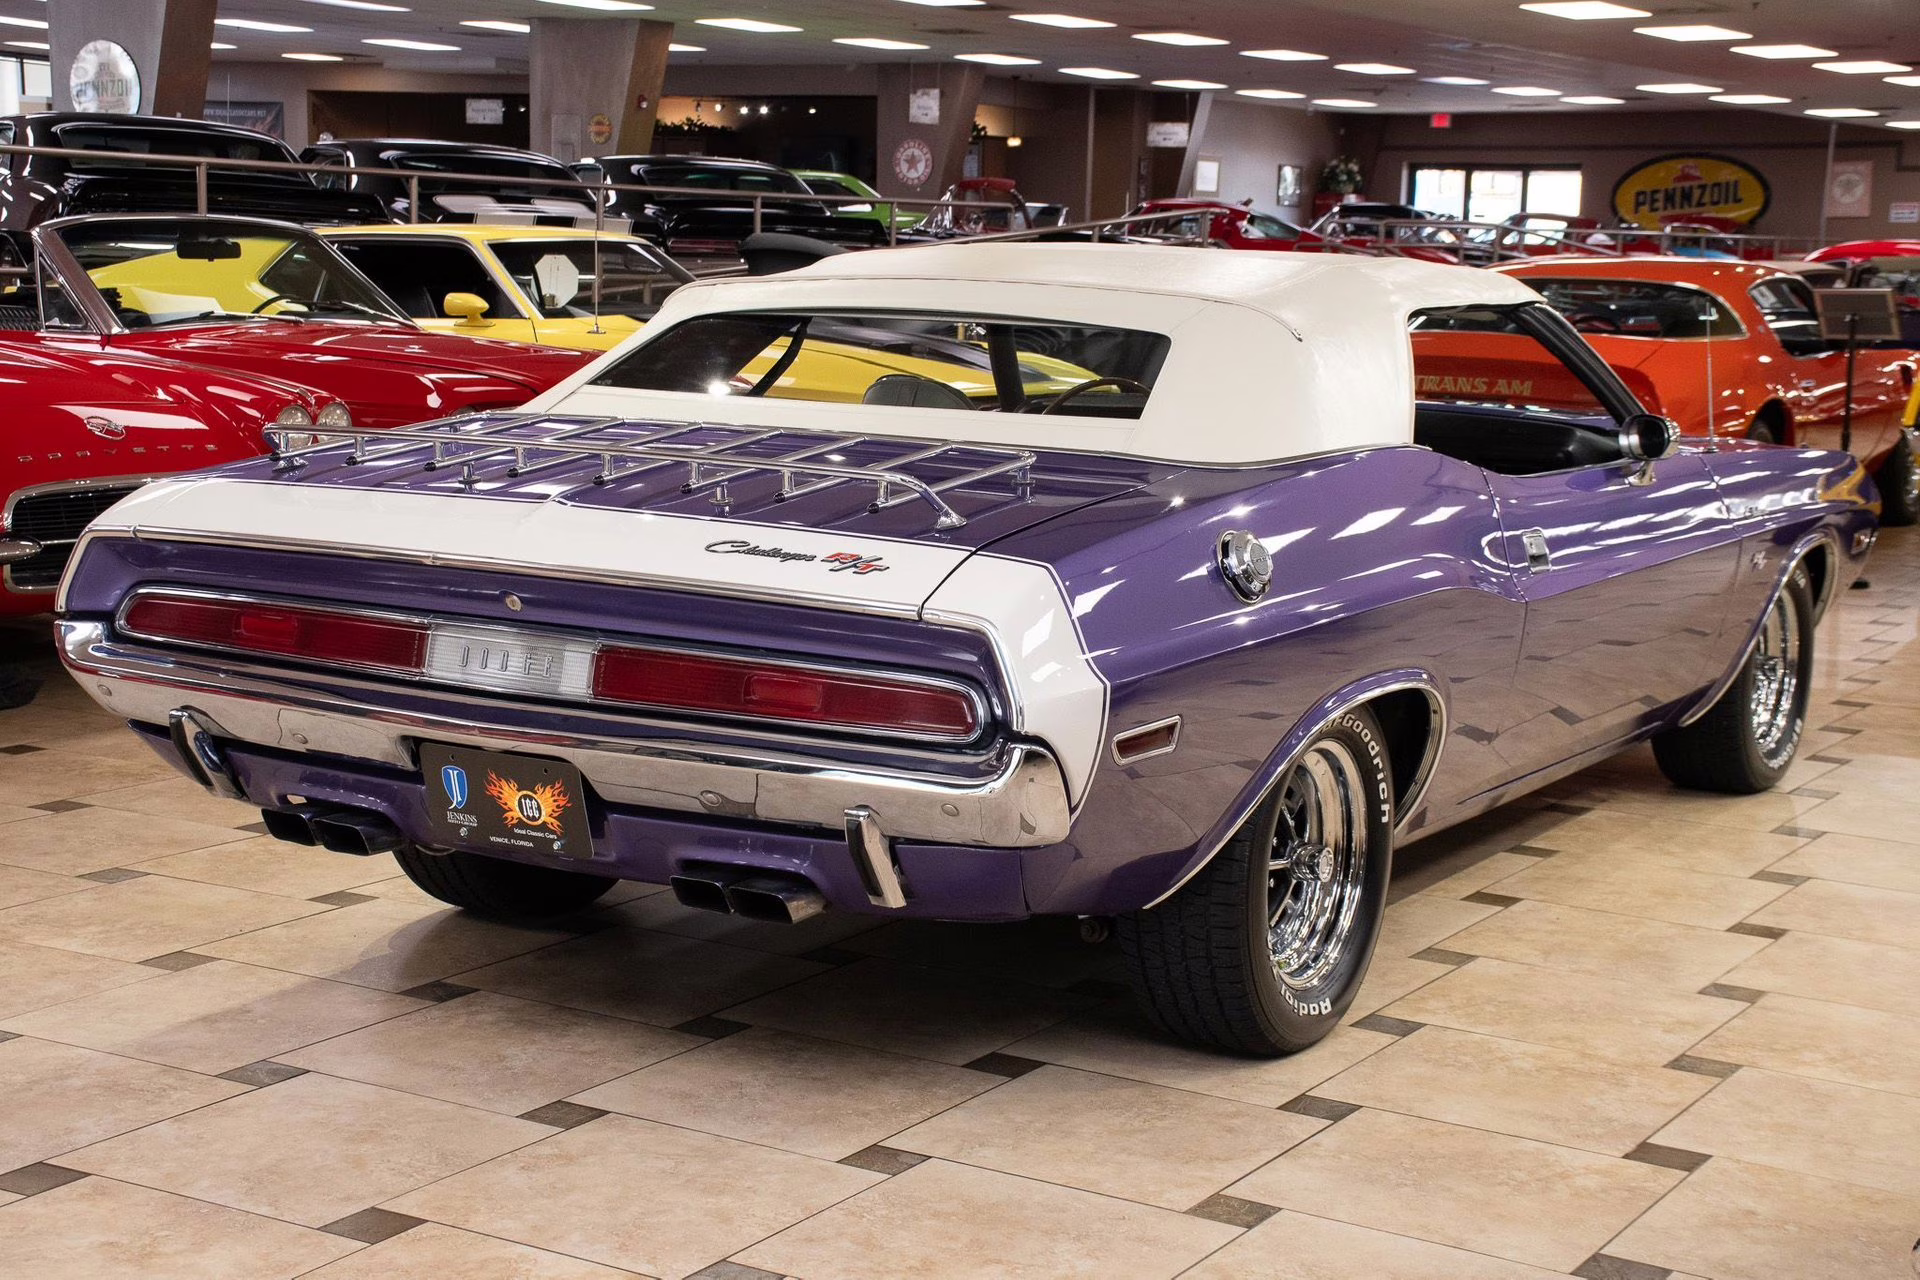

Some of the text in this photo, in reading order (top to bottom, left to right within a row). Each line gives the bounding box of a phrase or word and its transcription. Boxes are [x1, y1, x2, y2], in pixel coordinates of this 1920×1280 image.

[1634, 179, 1744, 215] PENNZOIL
[1492, 379, 1533, 396] AM
[820, 552, 890, 575] R/T
[459, 645, 553, 678] DODGE
[447, 811, 478, 823] JENKINS
[511, 839, 534, 848] FLORIDA
